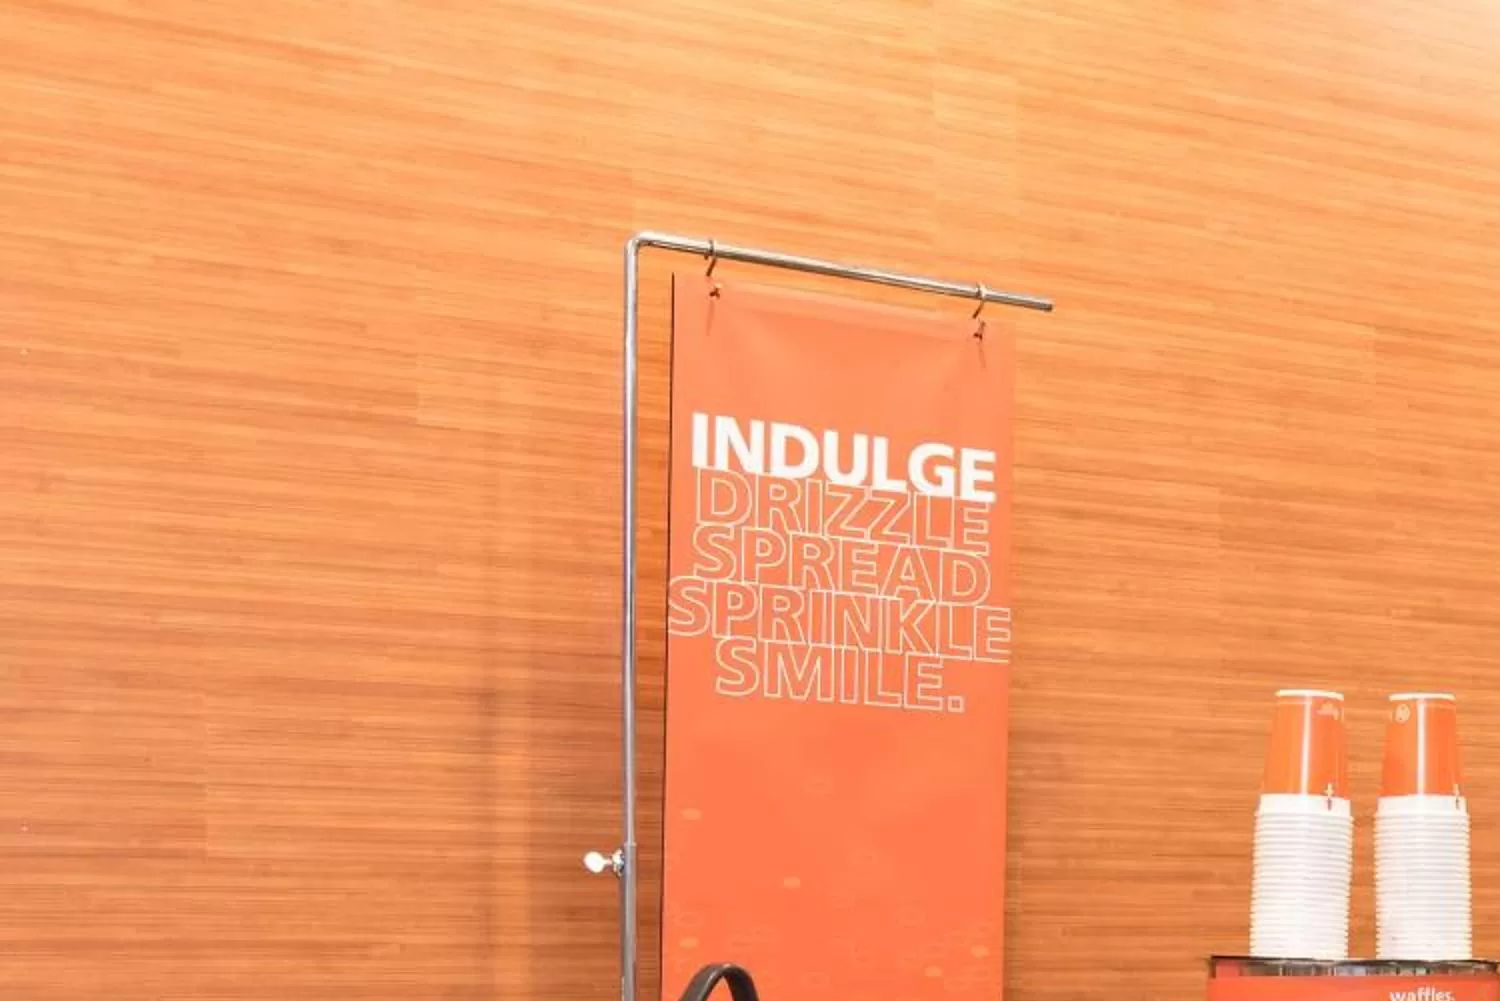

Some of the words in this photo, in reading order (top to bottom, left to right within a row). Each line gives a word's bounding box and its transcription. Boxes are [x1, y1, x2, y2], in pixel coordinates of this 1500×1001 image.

[691, 412, 997, 503] INDULGE
[695, 467, 991, 557] DRIZZLE
[692, 523, 991, 608] SPREAD
[667, 575, 1012, 663] SPRINKLE
[715, 636, 965, 713] SMILE.
